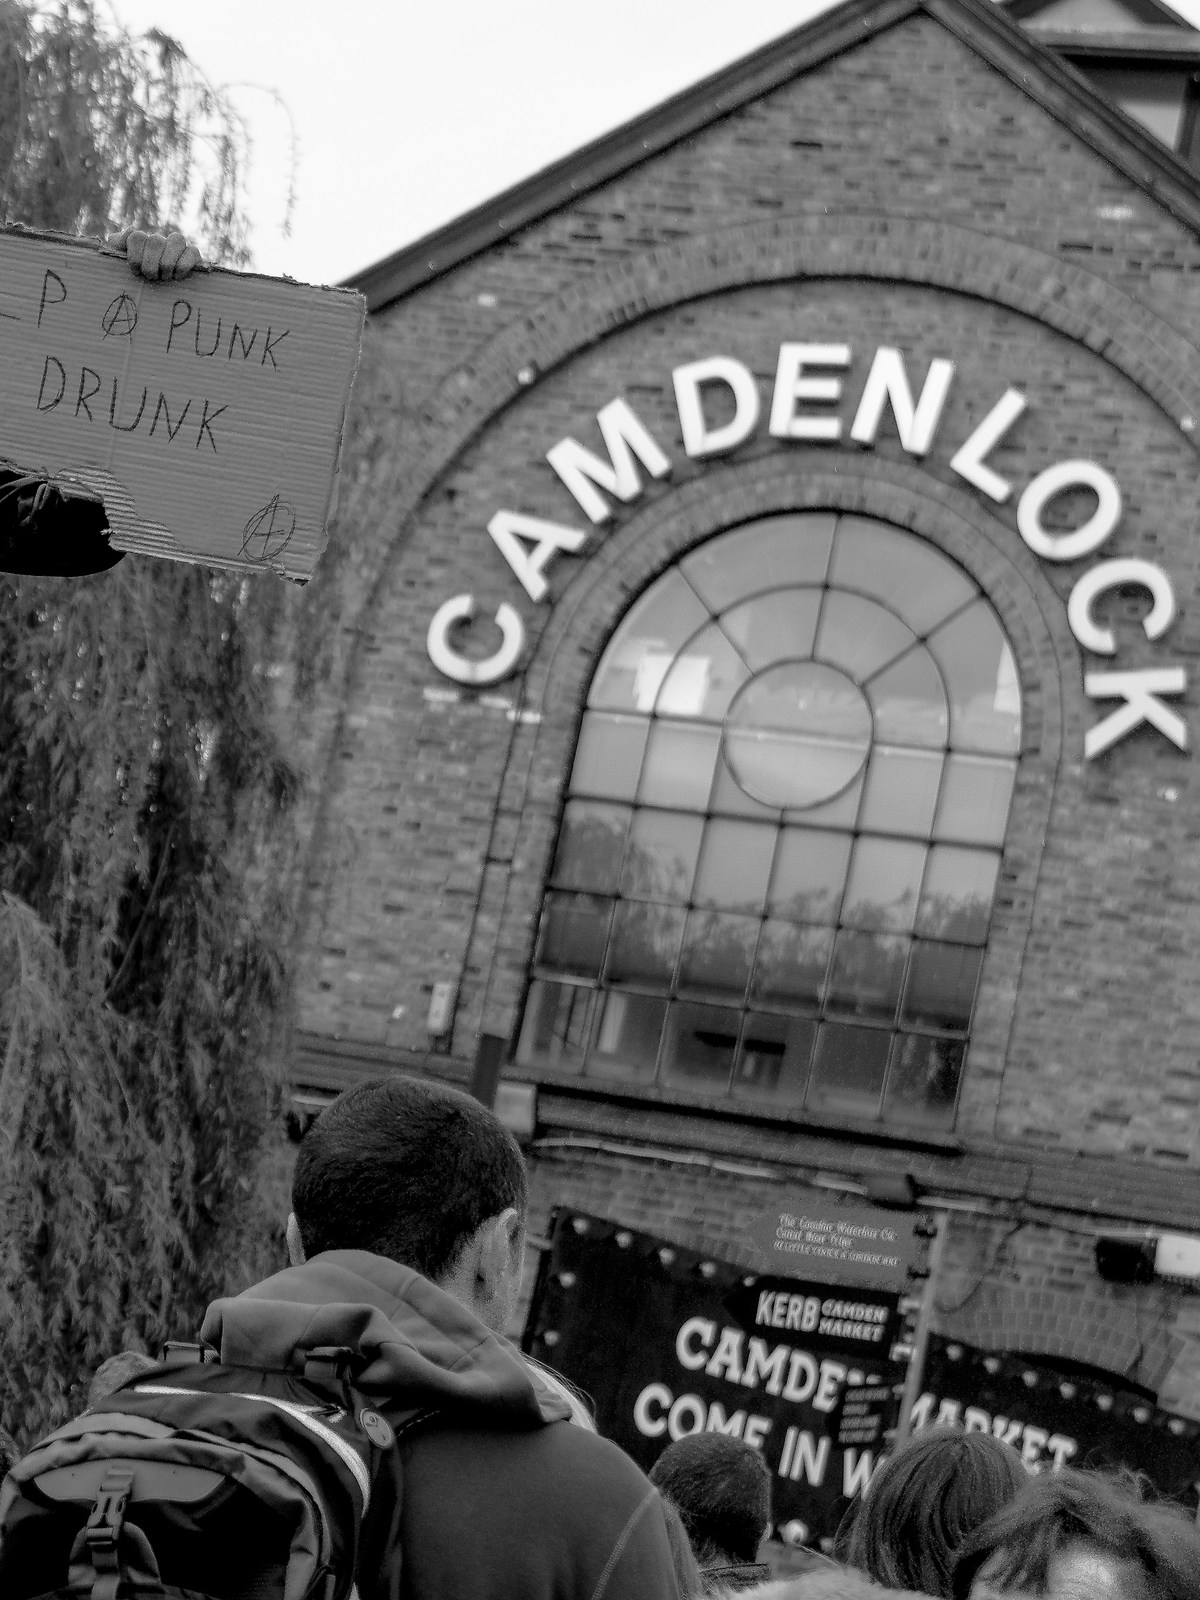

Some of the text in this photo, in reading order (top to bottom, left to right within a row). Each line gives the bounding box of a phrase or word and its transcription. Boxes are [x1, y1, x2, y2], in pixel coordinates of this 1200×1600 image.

[165, 299, 291, 373] PUNK
[35, 355, 228, 453] DRUNK
[426, 342, 1188, 759] CAMDEN LOCK
[755, 1290, 821, 1332] KERB
[818, 1317, 886, 1342] MARKET
[821, 1299, 890, 1324] CAMDEN
[676, 1316, 883, 1413] CAMDE
[633, 1382, 773, 1448] COME
[777, 1425, 832, 1487] IN
